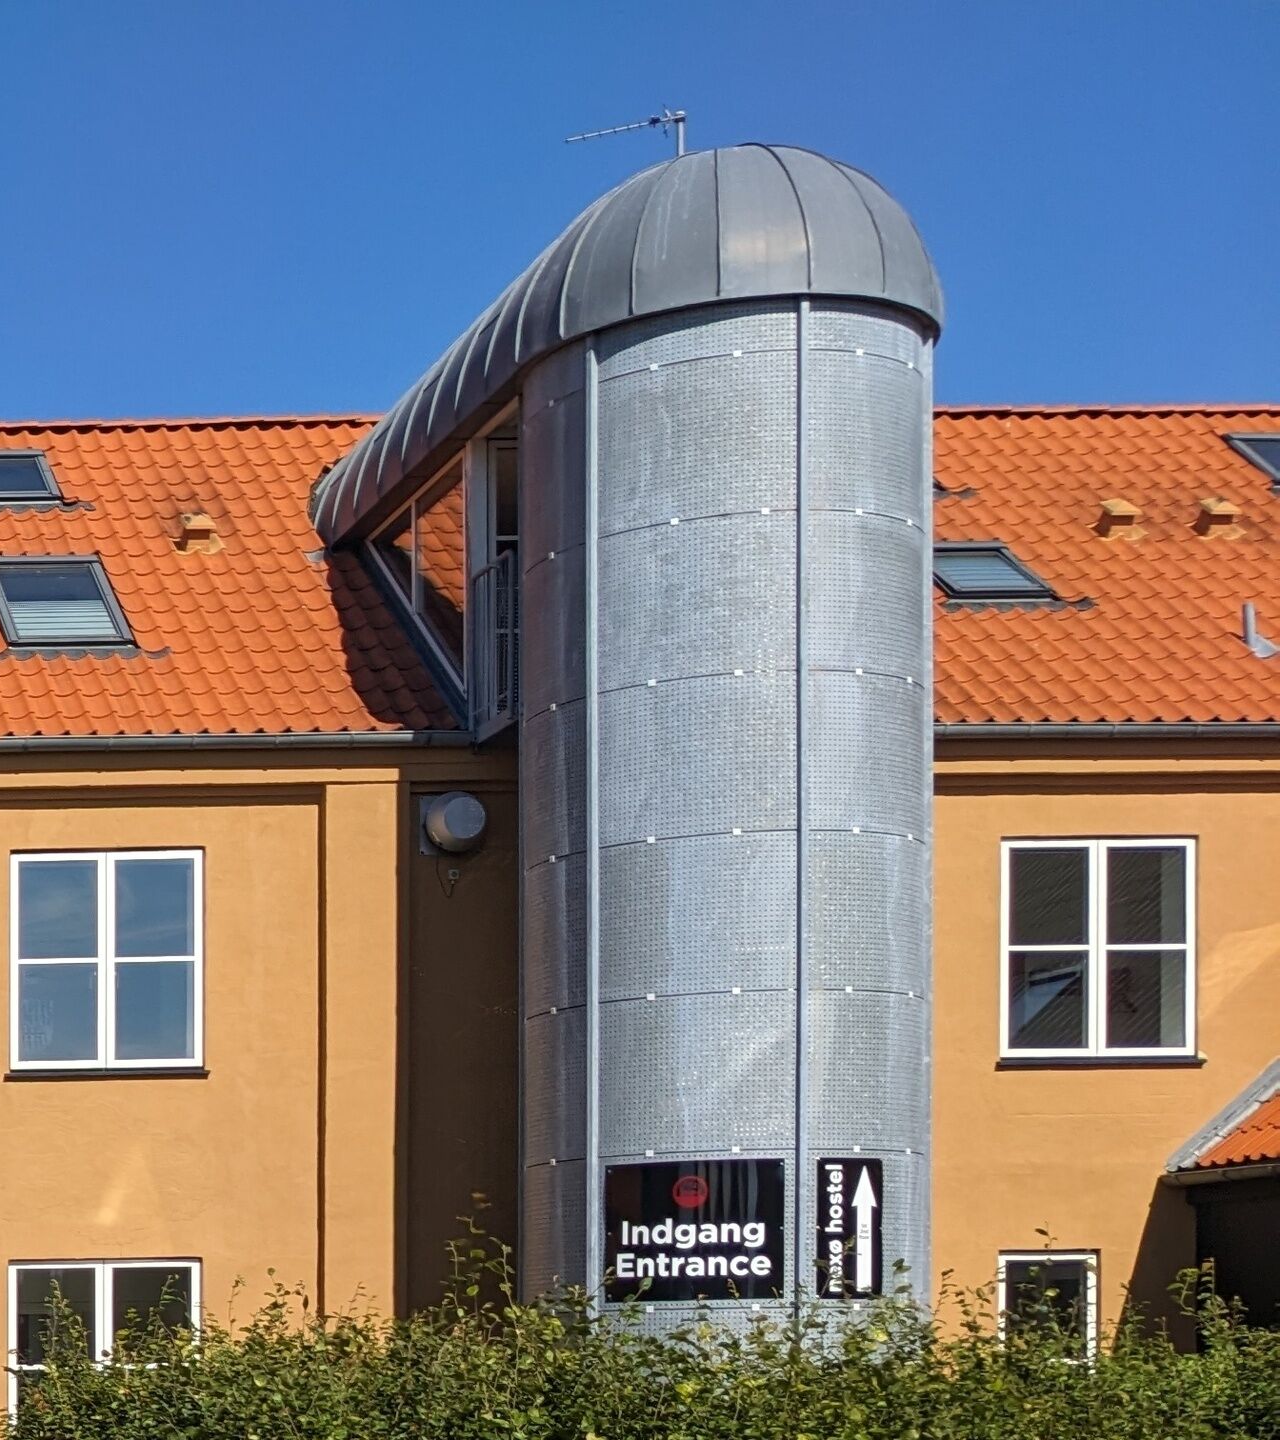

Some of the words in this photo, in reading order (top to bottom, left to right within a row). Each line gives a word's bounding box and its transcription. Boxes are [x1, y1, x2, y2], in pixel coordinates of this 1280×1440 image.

[824, 1164, 844, 1233] hostel
[621, 1218, 766, 1249] Indgang
[616, 1252, 772, 1278] Entrance
